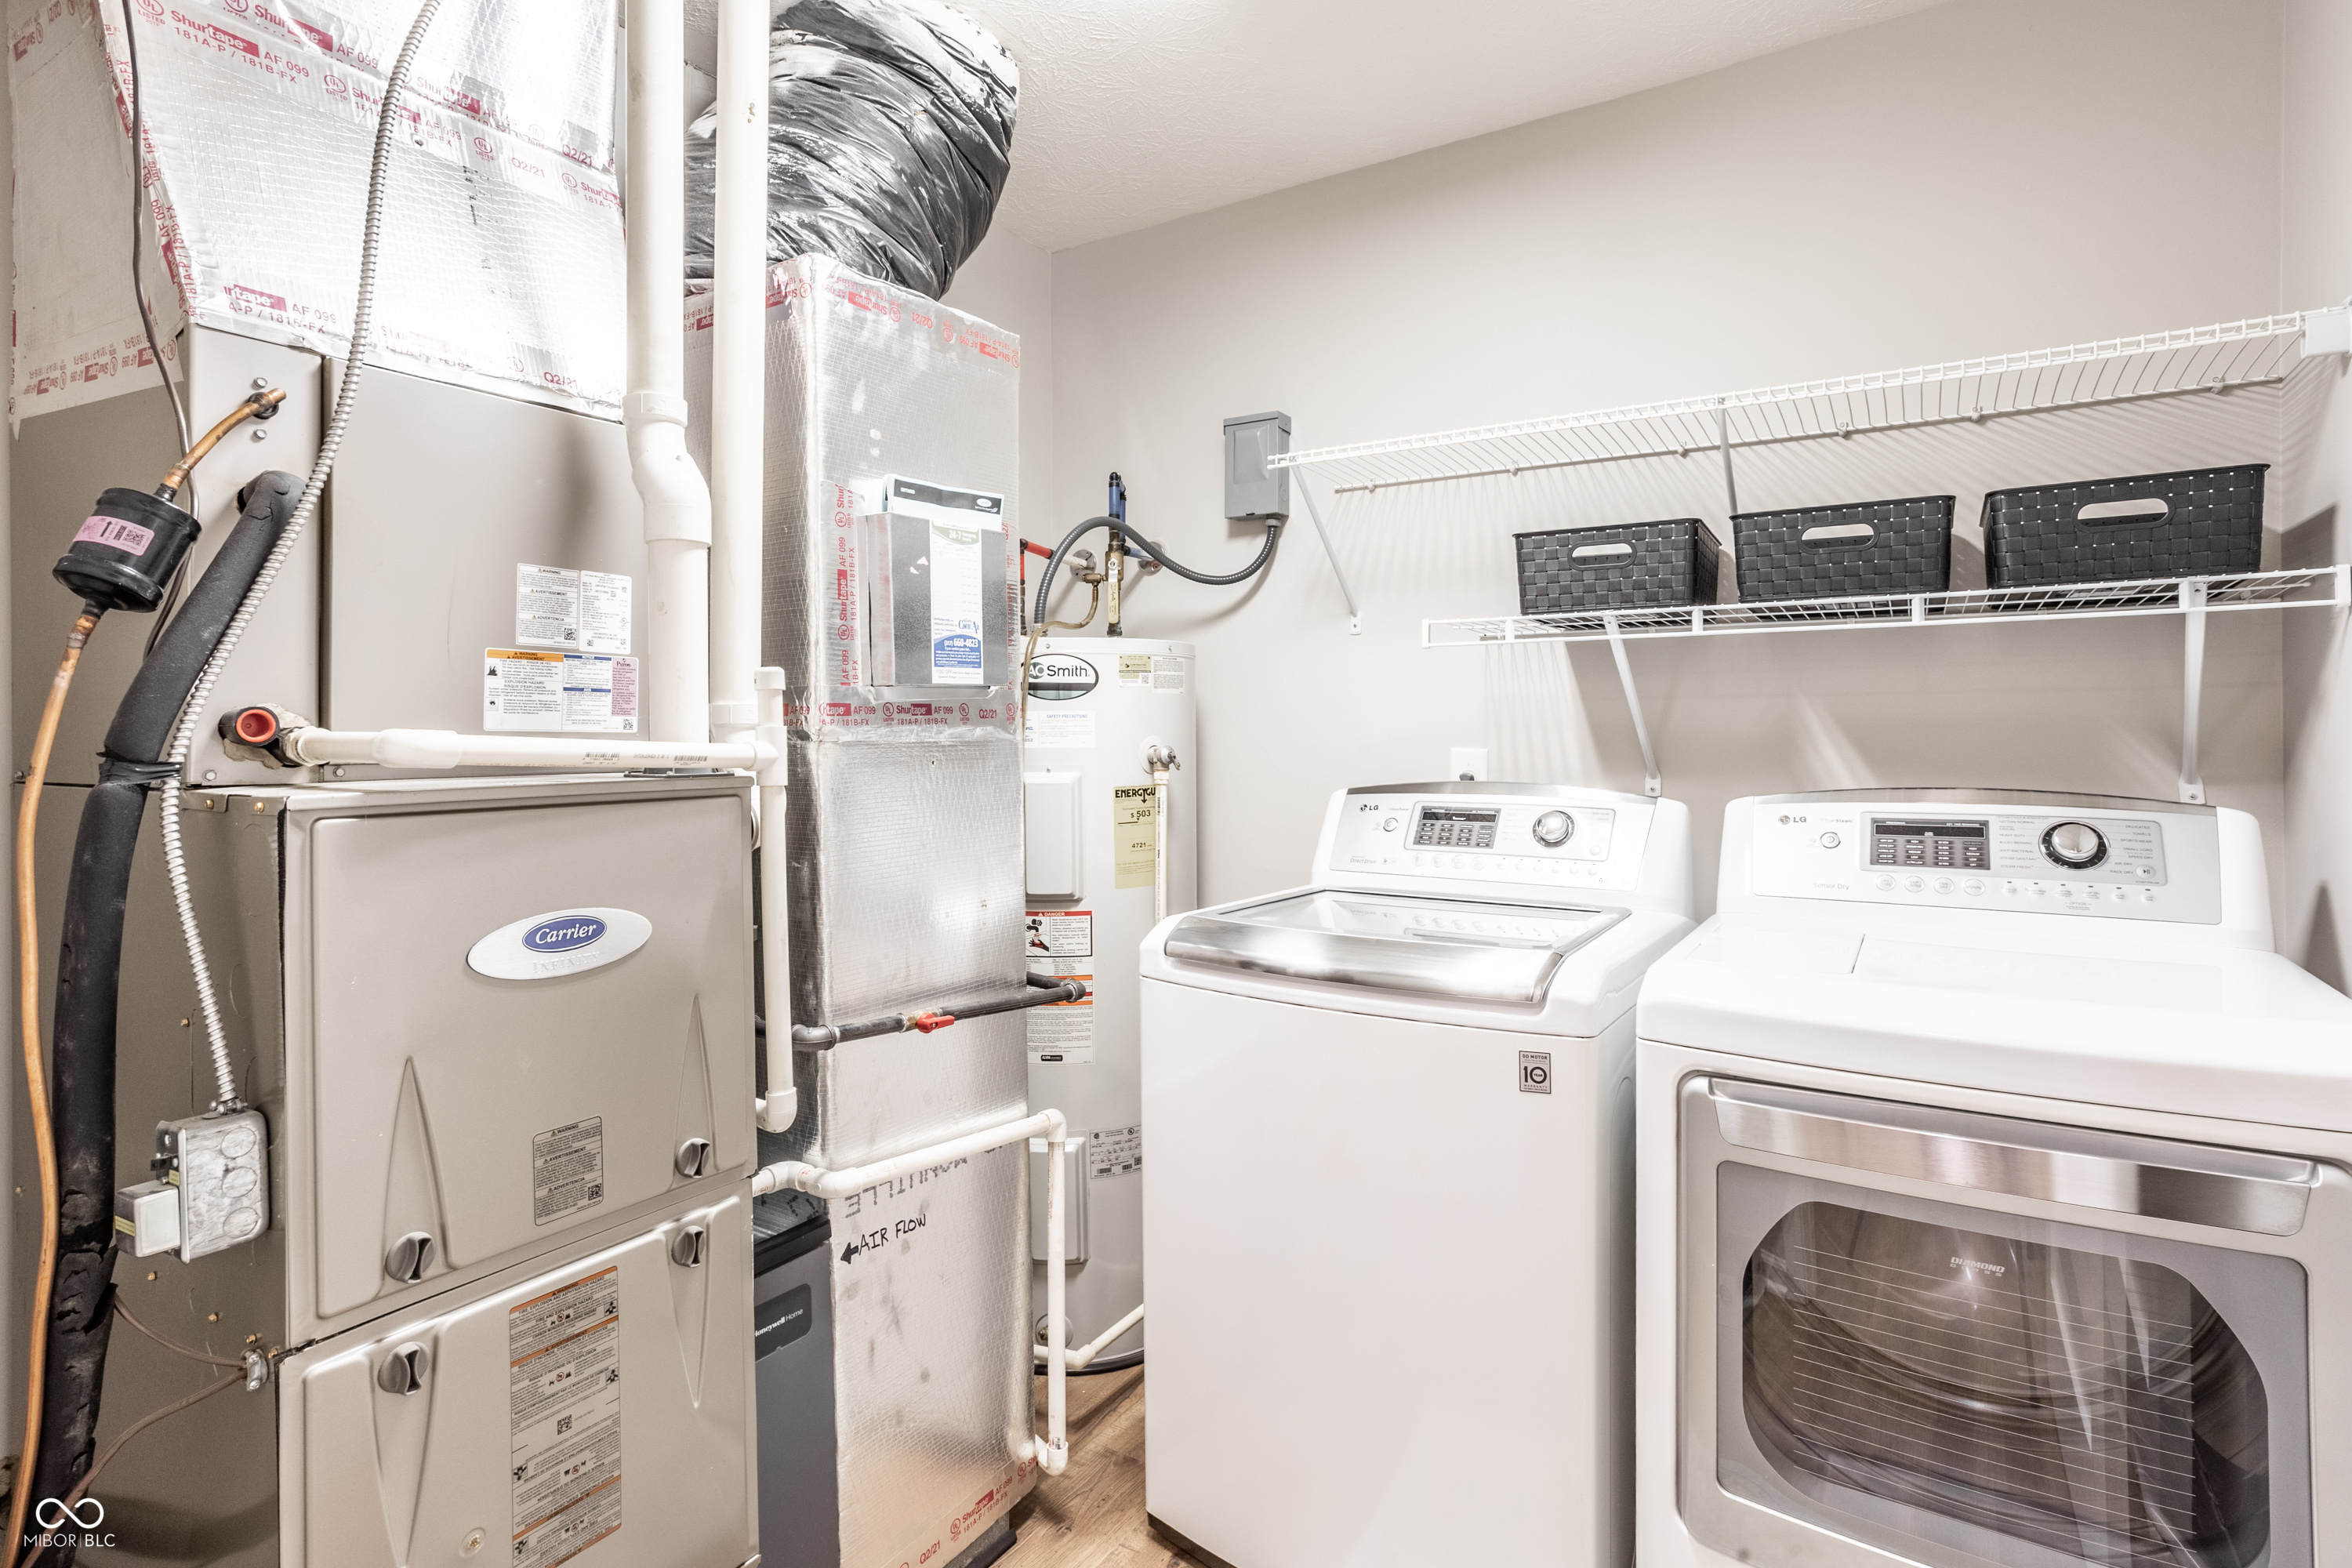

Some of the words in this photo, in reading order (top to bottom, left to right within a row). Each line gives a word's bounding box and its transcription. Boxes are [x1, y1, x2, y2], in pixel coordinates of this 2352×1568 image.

[171, 10, 245, 49] Shurtape
[264, 51, 281, 65] AF
[286, 60, 310, 78] 099
[174, 27, 226, 53] 181A-P
[241, 55, 297, 84] 181B-FX
[337, 43, 354, 57] AF
[358, 53, 378, 69] 099
[326, 89, 347, 101] LISTED
[425, 119, 440, 130] AF
[442, 128, 462, 140] 099
[475, 151, 494, 161] LISTED
[562, 144, 592, 166] Q2/21
[511, 157, 545, 178] Q2/21
[151, 199, 165, 220] 099
[158, 221, 171, 238] AF
[292, 303, 310, 315] AF
[314, 309, 336, 323] 099
[853, 296, 887, 316] Shurtape
[911, 311, 933, 329] Q2/21
[959, 336, 970, 346] 099
[965, 327, 988, 342] 181B-FX
[970, 339, 978, 350] AF
[993, 339, 1011, 351] 181A-P
[983, 345, 1011, 363] Shurtape
[949, 530, 960, 539] 24-7
[840, 555, 846, 567] AF
[953, 638, 978, 648] 660-4823
[843, 667, 849, 680] AF
[799, 706, 810, 715] 099
[864, 706, 876, 715] 099
[896, 705, 927, 715] Shurtape
[934, 706, 942, 714] AF
[943, 706, 953, 714] 099
[979, 709, 997, 719] Q2/21
[535, 924, 597, 944] Carrier
[533, 952, 601, 974] INFINITY
[1523, 1066, 1547, 1084] 10
[557, 1124, 579, 1134] WARNING
[549, 1146, 586, 1162] AVERTISSEMENT
[554, 1177, 585, 1191] ADVERTENCIA
[858, 1228, 889, 1256] AIR
[895, 1214, 927, 1239] FLOW
[1951, 1257, 2005, 1272] DIAMOND
[530, 1298, 553, 1311] EXPLOSION
[562, 1283, 589, 1297] ASPHYXIATION
[590, 1276, 604, 1286] HAZARD
[557, 1282, 579, 1294] WARNING
[555, 1303, 577, 1315] EXPLOSION
[578, 1296, 593, 1305] HAZARD
[583, 1308, 597, 1316] HAZARD
[786, 1309, 803, 1321] Home
[518, 1360, 532, 1369] RISQUE
[557, 1339, 581, 1352] D'EXPLOSION
[587, 1326, 608, 1338] D'ASPHYXIE
[529, 1373, 543, 1382] RISQUE
[544, 1363, 565, 1375] D'INCENDIE
[573, 1348, 597, 1362] D'EXPLOSION
[963, 1497, 989, 1523] Shurtape
[996, 1486, 1002, 1495] AF
[1004, 1476, 1012, 1489] 099
[964, 1514, 982, 1533] 181A-P
[986, 1491, 1008, 1512] 181B-FX
[920, 1540, 940, 1564] Q2/21
